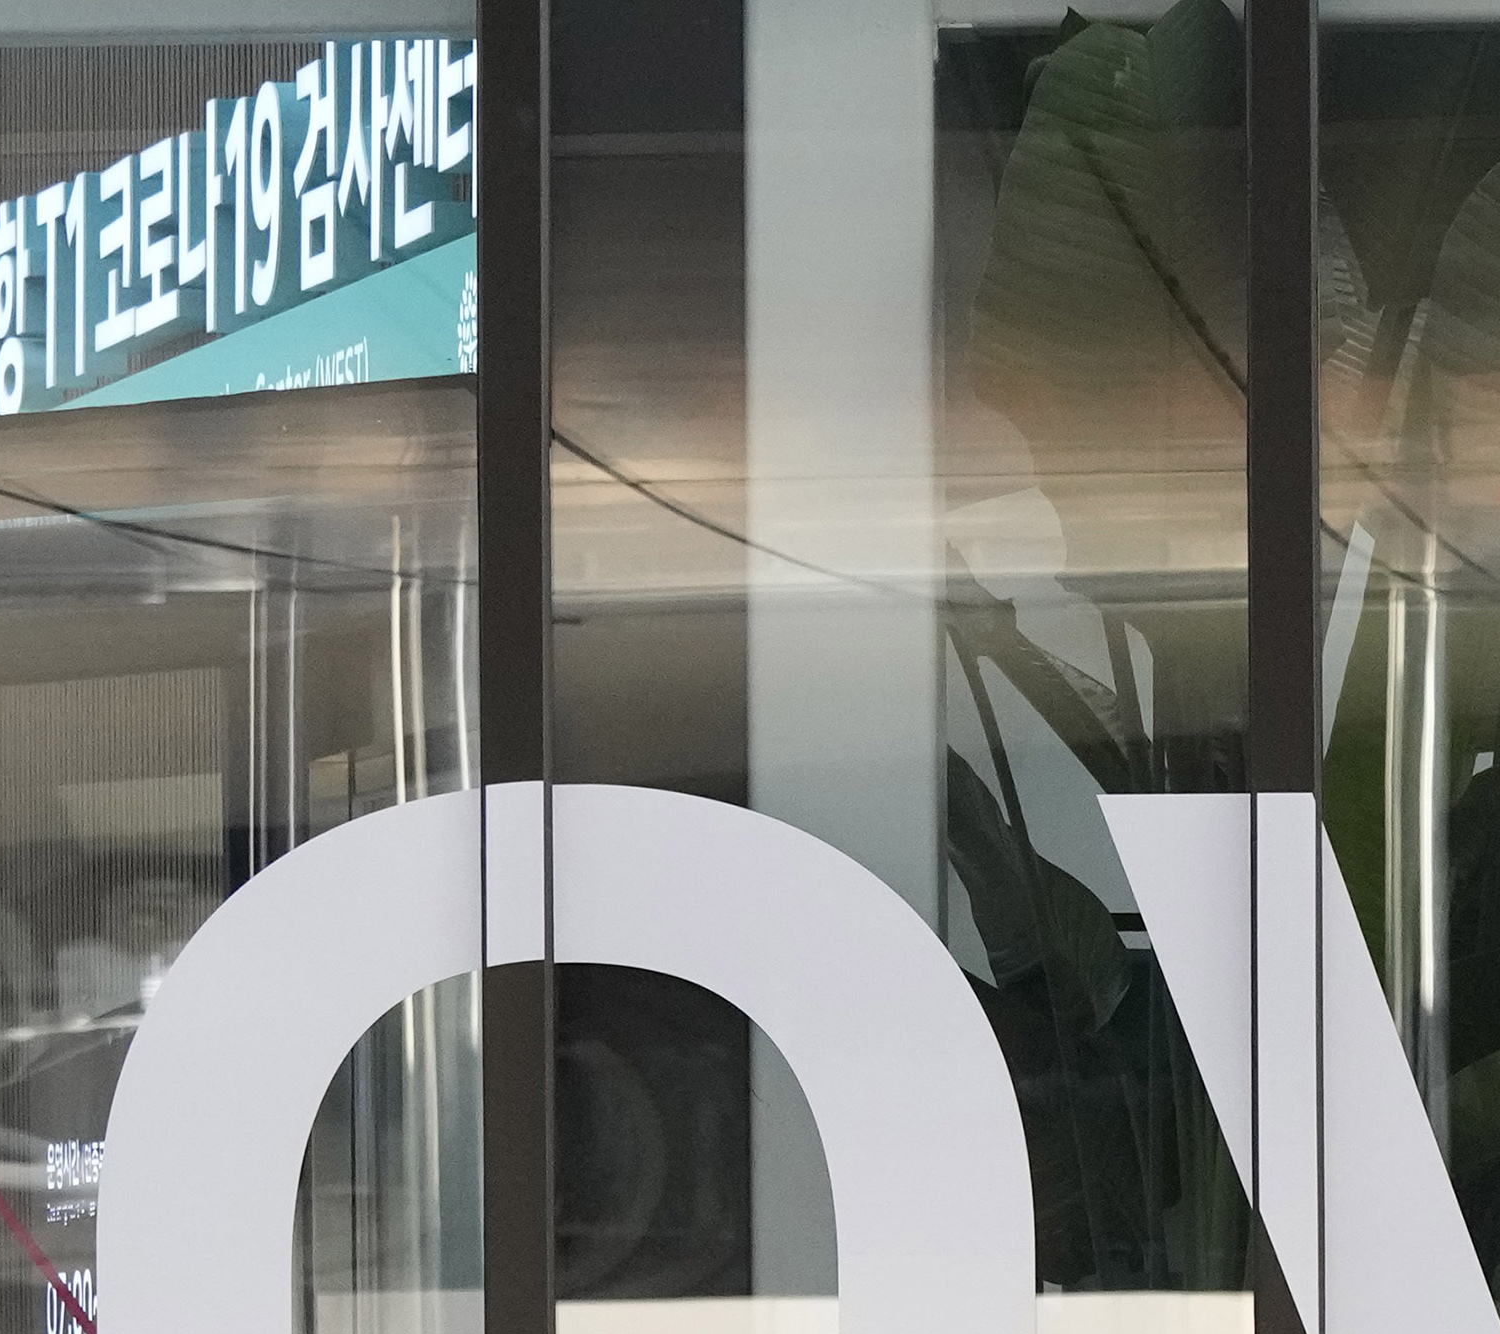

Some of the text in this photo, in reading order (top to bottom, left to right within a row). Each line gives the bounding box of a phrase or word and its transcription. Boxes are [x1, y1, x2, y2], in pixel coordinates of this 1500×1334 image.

[36, 172, 86, 389] T1
[94, 81, 282, 351] 코로나19
[293, 40, 478, 292] 검사센터
[255, 364, 312, 391] Cter
[47, 1139, 80, 1190] 운영시간
